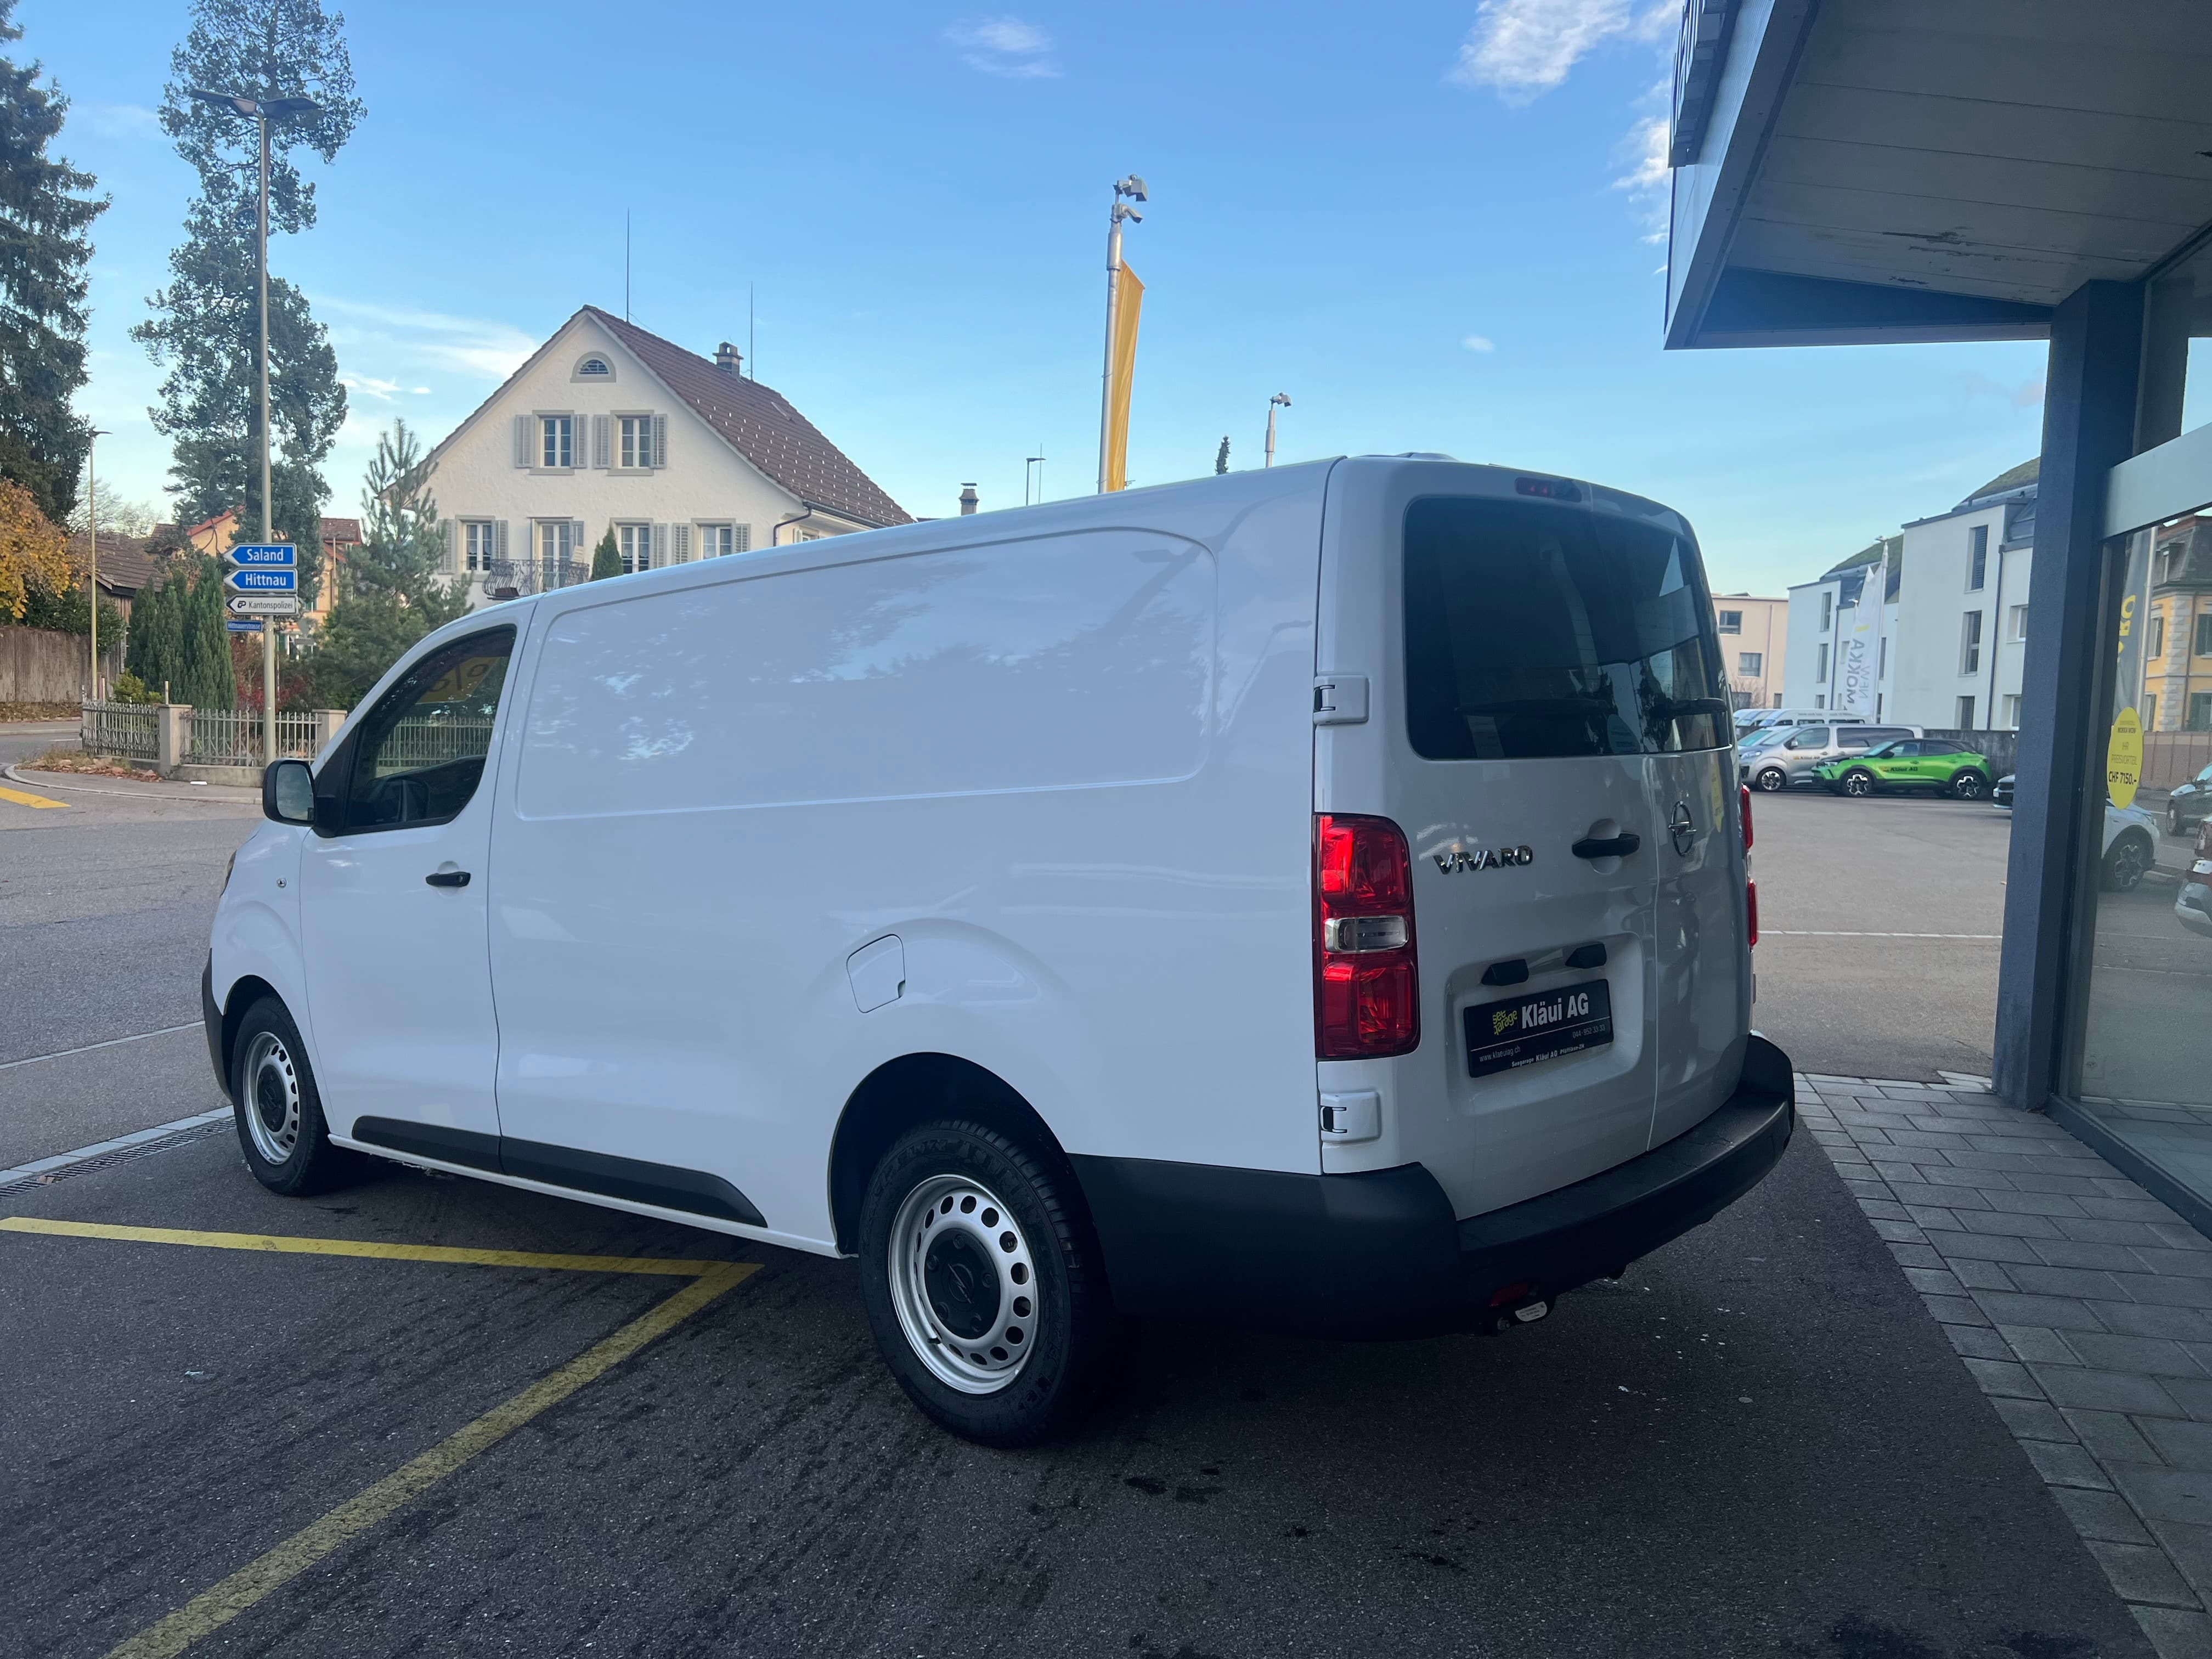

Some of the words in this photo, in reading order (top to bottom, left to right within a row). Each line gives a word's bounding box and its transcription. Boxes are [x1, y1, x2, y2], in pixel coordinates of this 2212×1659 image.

[246, 548, 284, 561] Saland
[245, 573, 286, 586] Hittnau
[249, 601, 293, 611] Kantonspolizei
[2108, 771, 2119, 782] CHF
[2120, 772, 2137, 785] 7150.-
[1433, 845, 1533, 875] VIVARO
[1521, 997, 1562, 1029] Kläui
[1566, 992, 1589, 1019] AG
[1511, 1057, 1534, 1068] Seegarage
[1536, 1052, 1549, 1062] Kläui
[1550, 1050, 1558, 1058] AG
